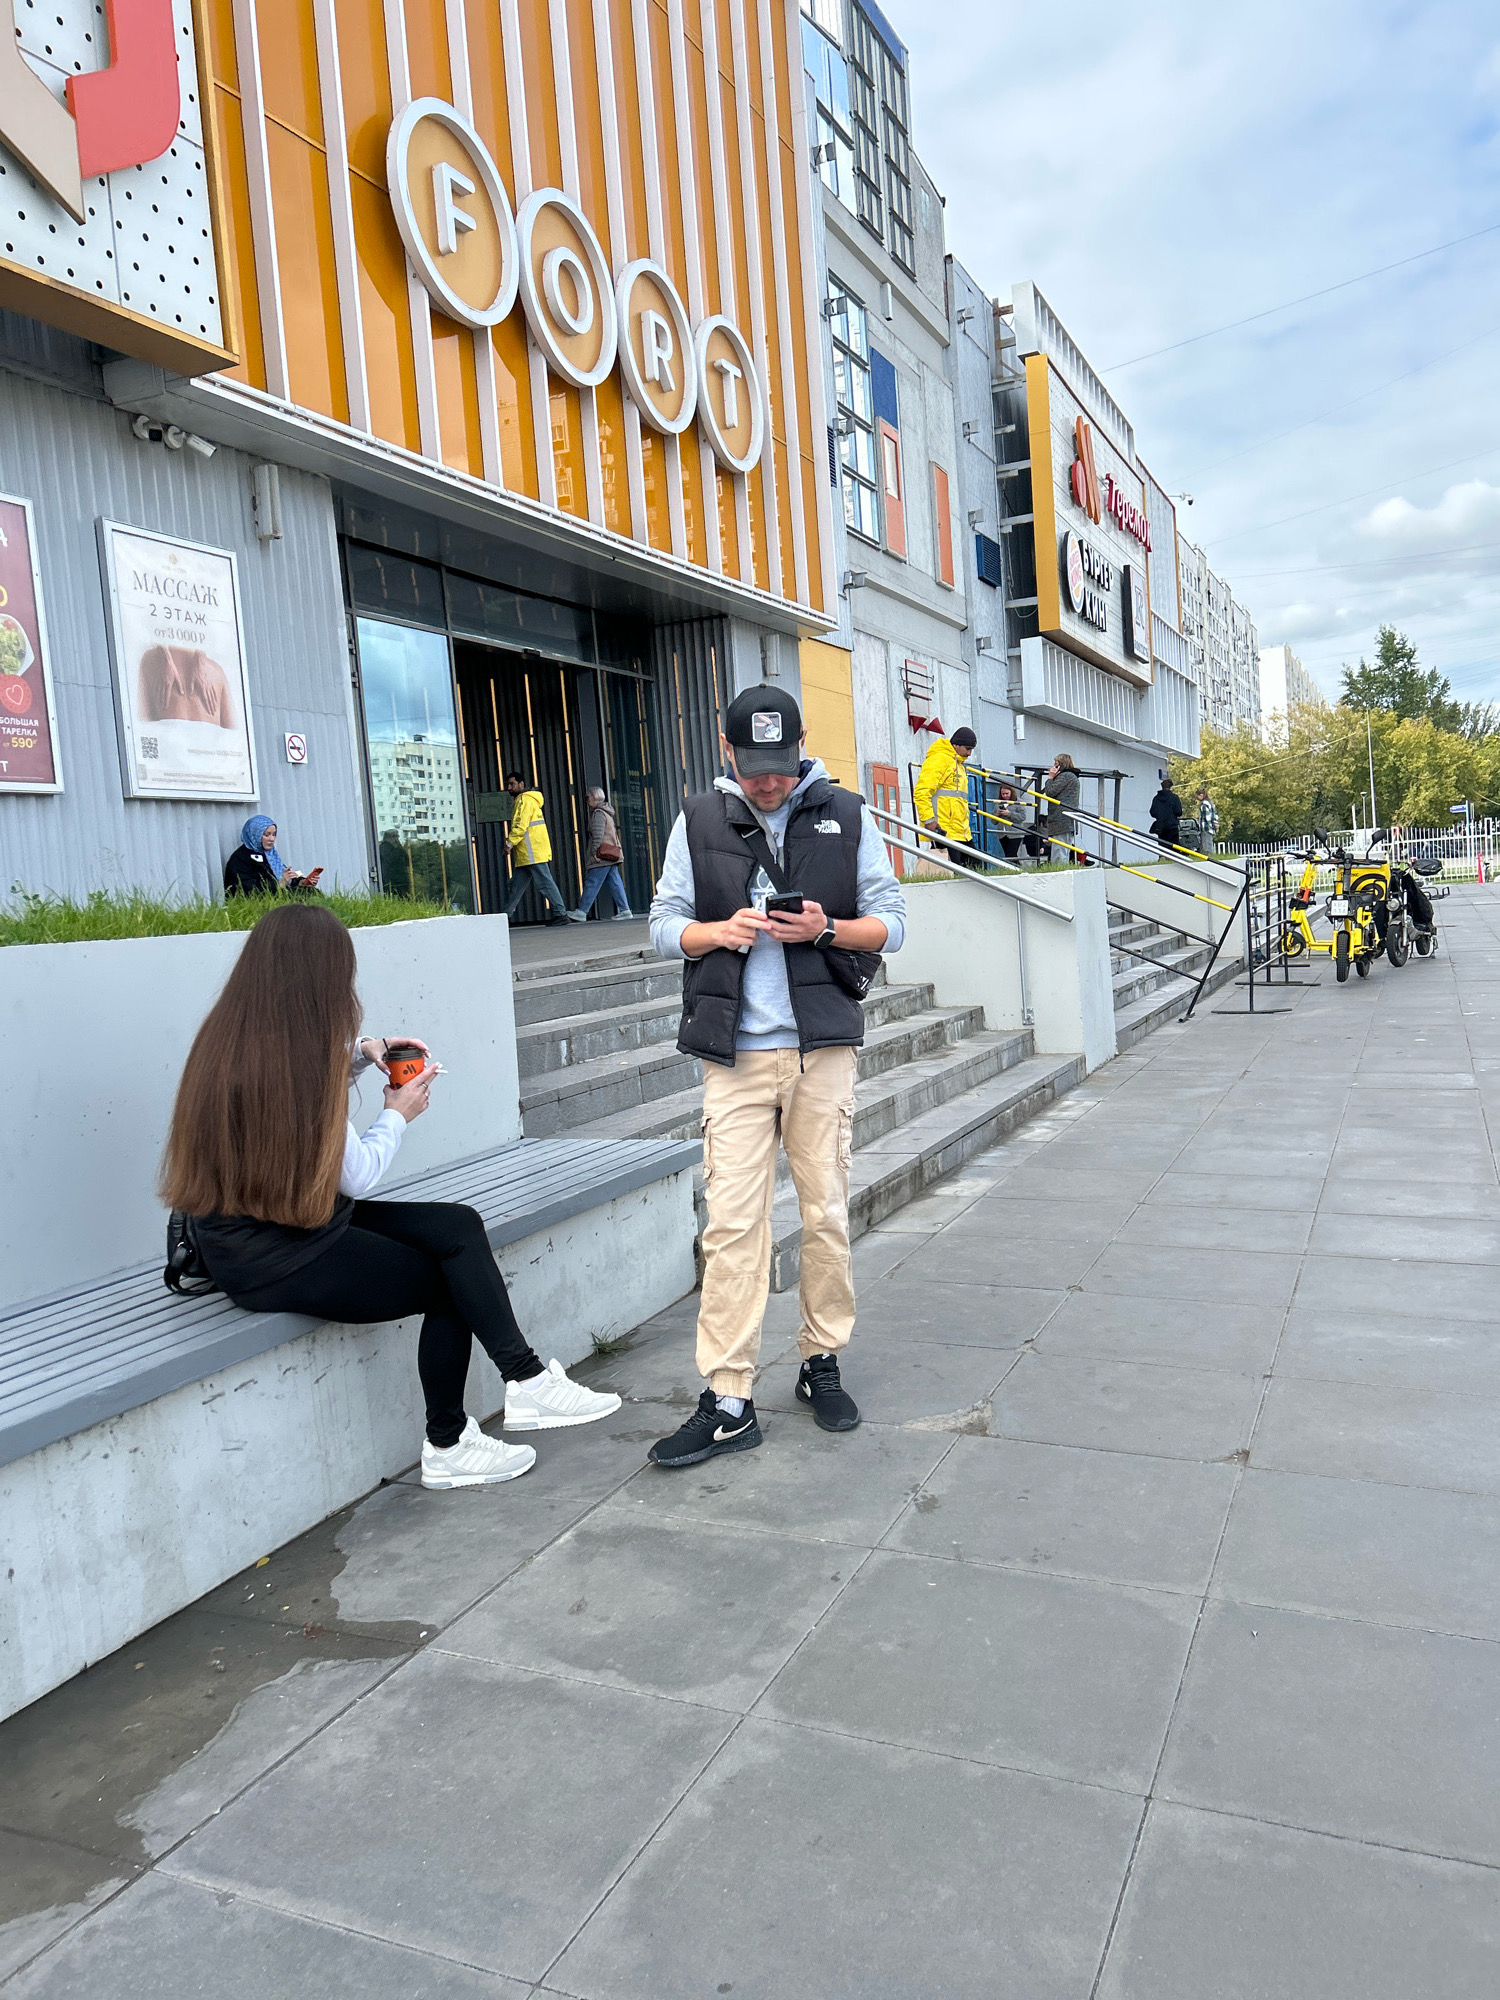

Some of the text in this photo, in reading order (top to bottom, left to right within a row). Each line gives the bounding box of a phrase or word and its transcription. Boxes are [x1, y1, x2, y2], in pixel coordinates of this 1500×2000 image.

[432, 162, 742, 429] FORT
[1080, 538, 1114, 591] БУРГЕР
[133, 570, 218, 606] МАССАЖ
[149, 603, 206, 626] 2 ЭТАЖ
[0, 716, 39, 727] БОЛЬШАЯ
[1, 727, 37, 736] ТАРЕЛКА
